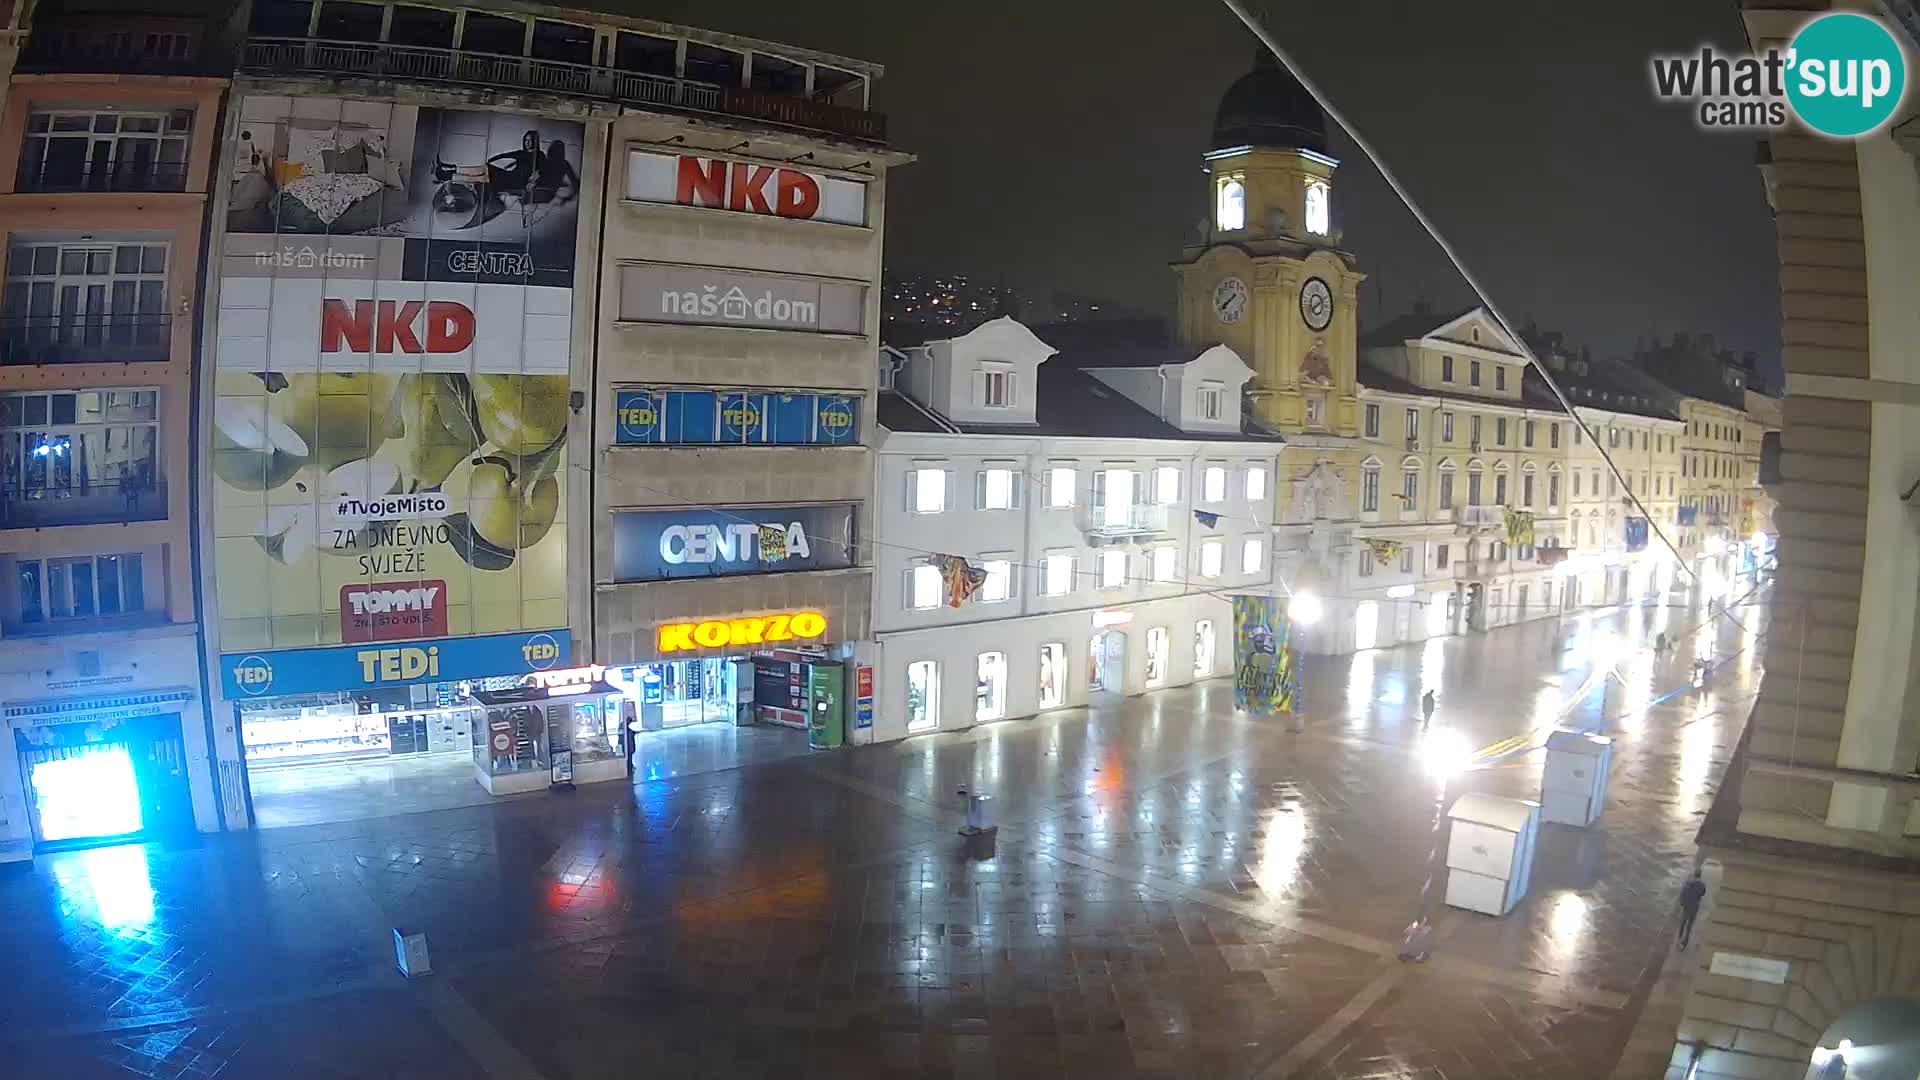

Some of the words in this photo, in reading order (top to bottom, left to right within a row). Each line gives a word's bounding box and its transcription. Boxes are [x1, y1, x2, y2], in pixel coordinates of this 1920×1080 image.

[676, 154, 820, 219] NKD
[255, 246, 293, 268] naš
[319, 247, 365, 269] dom
[448, 250, 535, 276] CENTRA
[661, 284, 718, 316] naš
[754, 289, 816, 323] dom
[321, 298, 477, 354] NKD
[618, 408, 658, 425] TEDi
[723, 408, 760, 426] TEDi
[337, 497, 446, 517] #TvojeMisto
[333, 528, 357, 549] ZA
[368, 523, 450, 548] DNEVNO
[659, 520, 810, 565] CENTA
[359, 547, 426, 576] SVJEŽE
[348, 586, 439, 615] TOMMY
[657, 611, 828, 653] KORZO
[357, 646, 440, 682] TEDi
[521, 642, 560, 662] TEDi
[233, 665, 273, 683] TEDi
